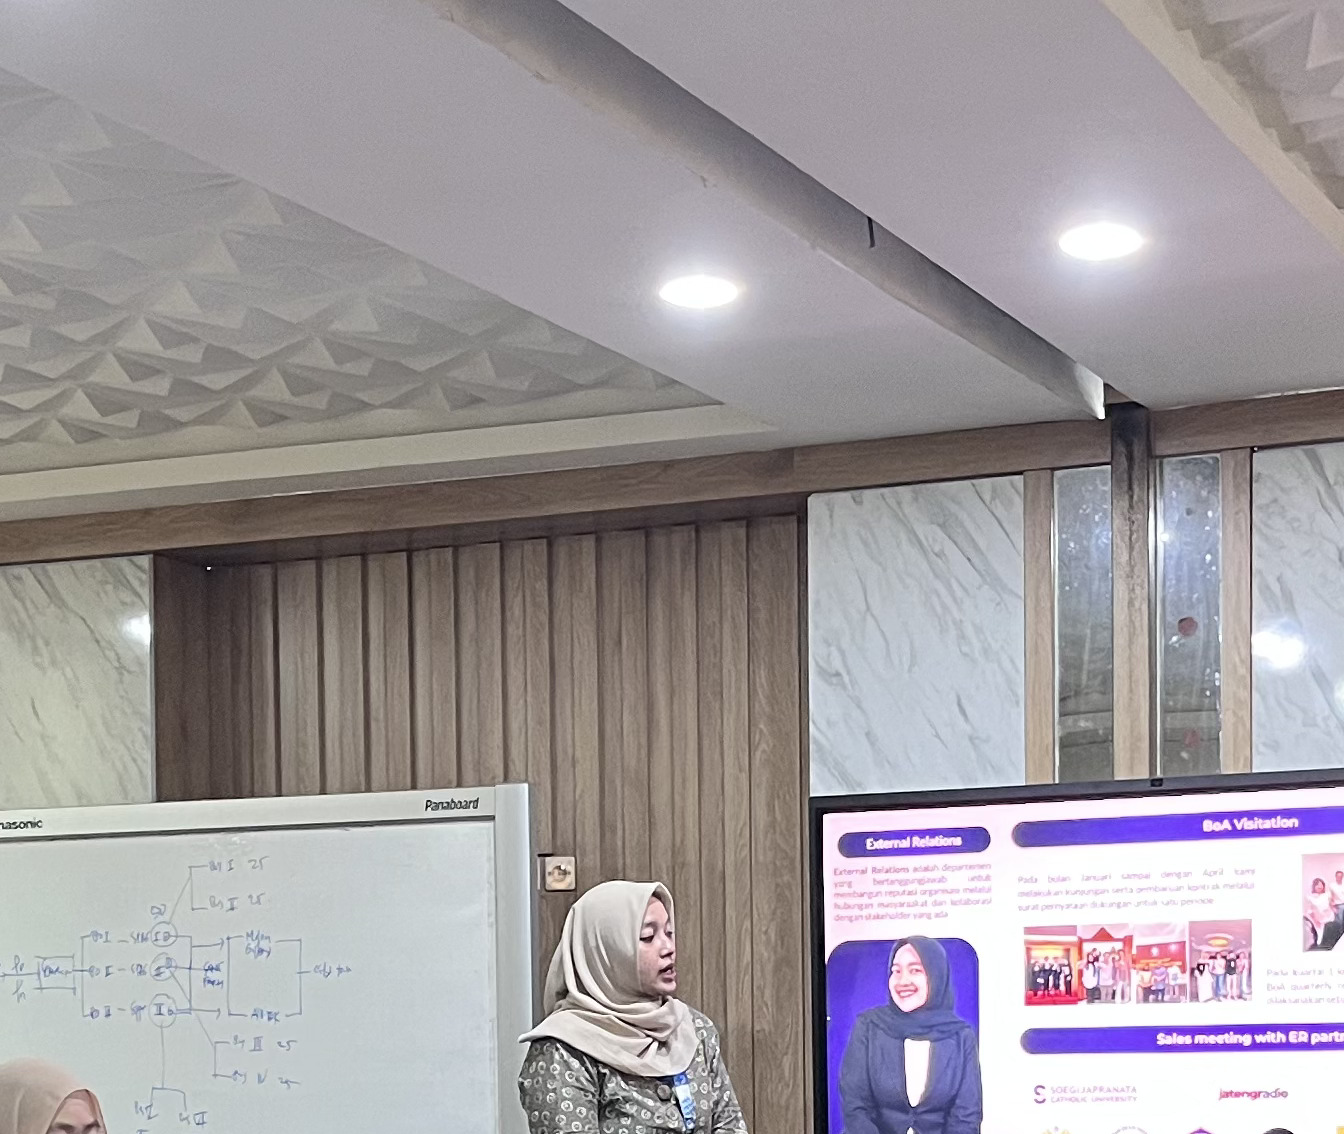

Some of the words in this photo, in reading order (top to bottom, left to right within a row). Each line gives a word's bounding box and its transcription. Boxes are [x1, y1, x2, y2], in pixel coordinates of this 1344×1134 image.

[425, 796, 480, 813] Panaboard
[1203, 819, 1232, 832] BoA
[1234, 815, 1299, 830] Visitation
[866, 837, 910, 850] External
[912, 835, 962, 847] Relations
[834, 867, 867, 875] External
[872, 866, 909, 874] Relations
[1156, 1033, 1192, 1045] Sales
[1195, 1032, 1252, 1046] meeting
[1255, 1031, 1286, 1043] with
[1289, 1031, 1309, 1042] ER
[1218, 1087, 1288, 1100] jatengradio
